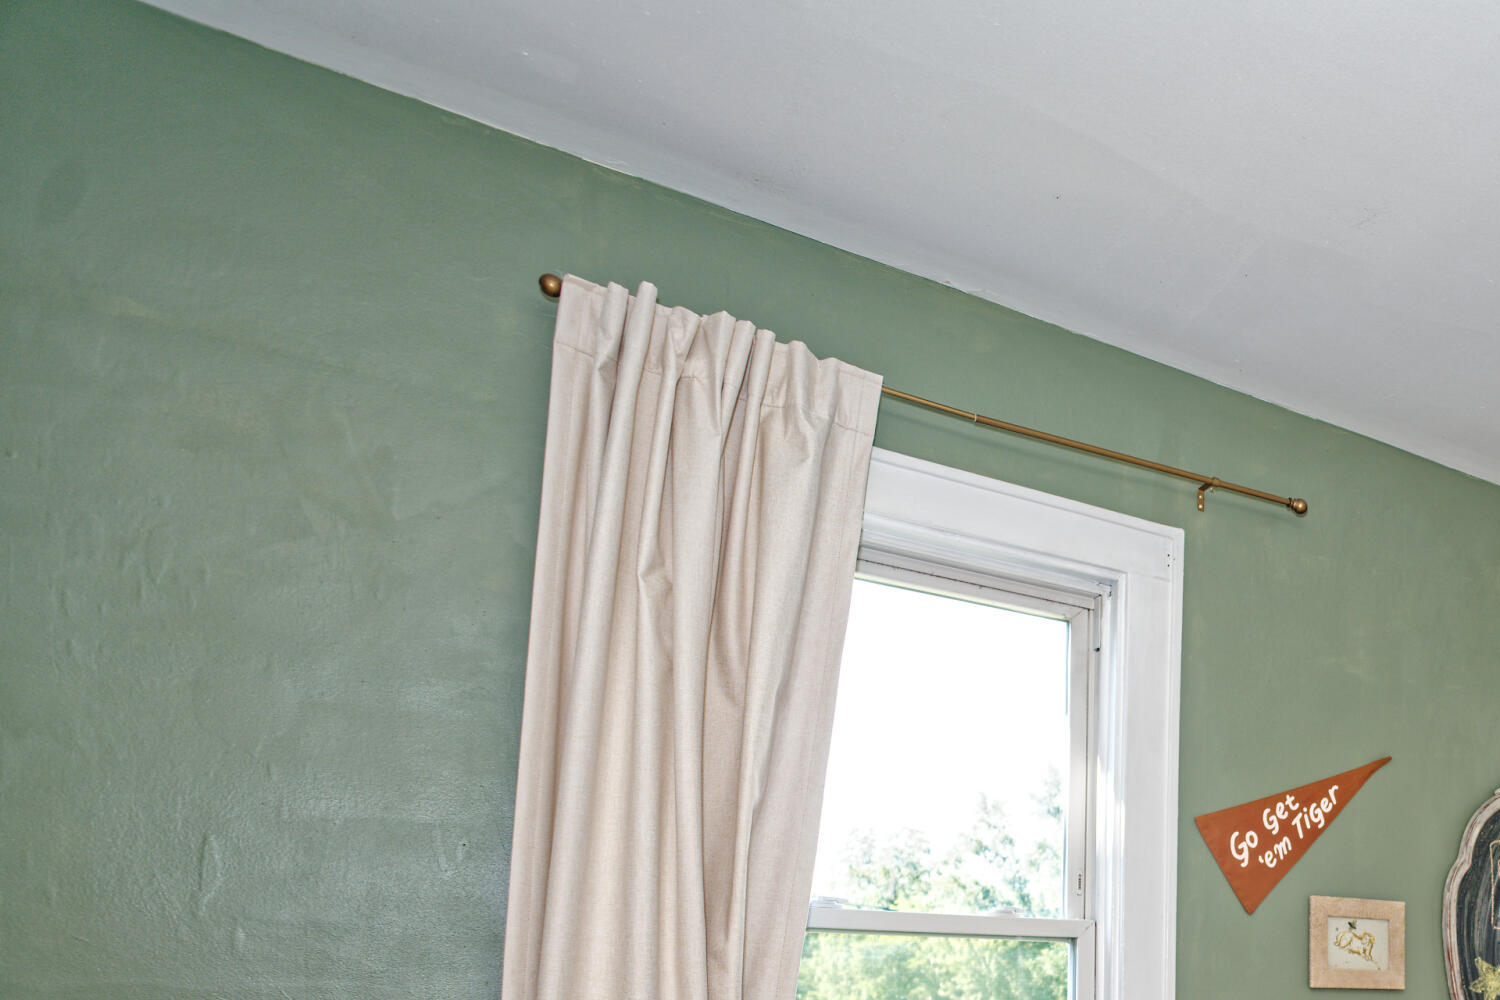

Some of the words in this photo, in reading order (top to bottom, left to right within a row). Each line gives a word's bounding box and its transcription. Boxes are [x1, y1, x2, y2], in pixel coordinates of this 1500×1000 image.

[1230, 830, 1259, 868] Go
[1262, 794, 1300, 836] Get
[1258, 836, 1293, 869] 'em
